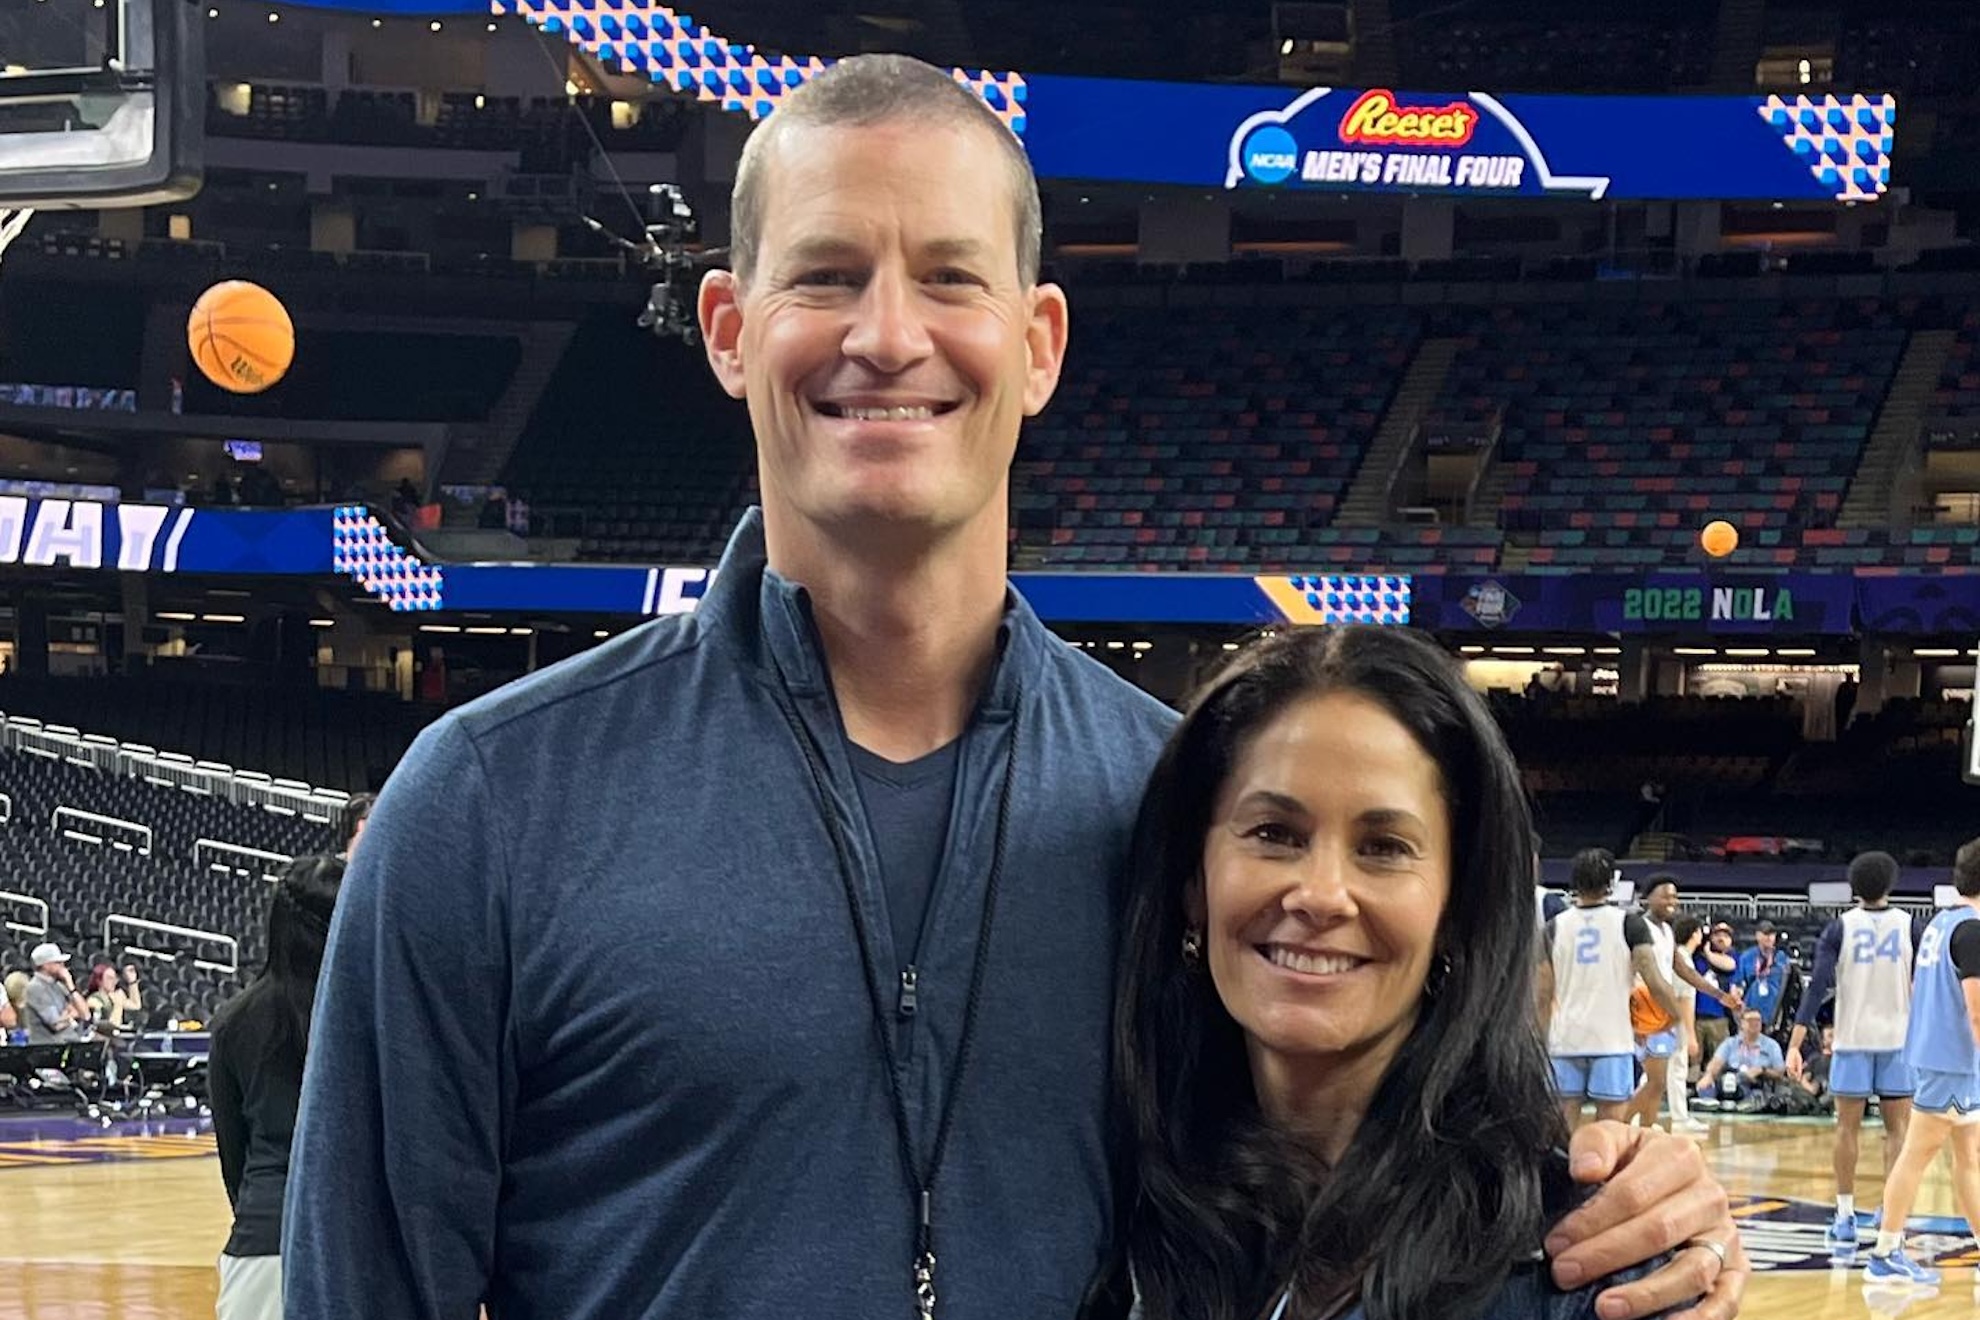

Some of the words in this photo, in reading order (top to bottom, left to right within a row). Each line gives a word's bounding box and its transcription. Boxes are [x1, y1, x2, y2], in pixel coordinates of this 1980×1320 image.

[1345, 94, 1471, 140] Reese's
[1250, 153, 1296, 168] NCAA
[1301, 150, 1384, 183] MEN'S
[1383, 154, 1452, 185] FINAL
[1454, 156, 1525, 187] FOUR
[1623, 588, 1702, 619] 2022
[1711, 587, 1794, 620] NOLA
[1576, 927, 1601, 964] 2
[1852, 927, 1902, 964] 24
